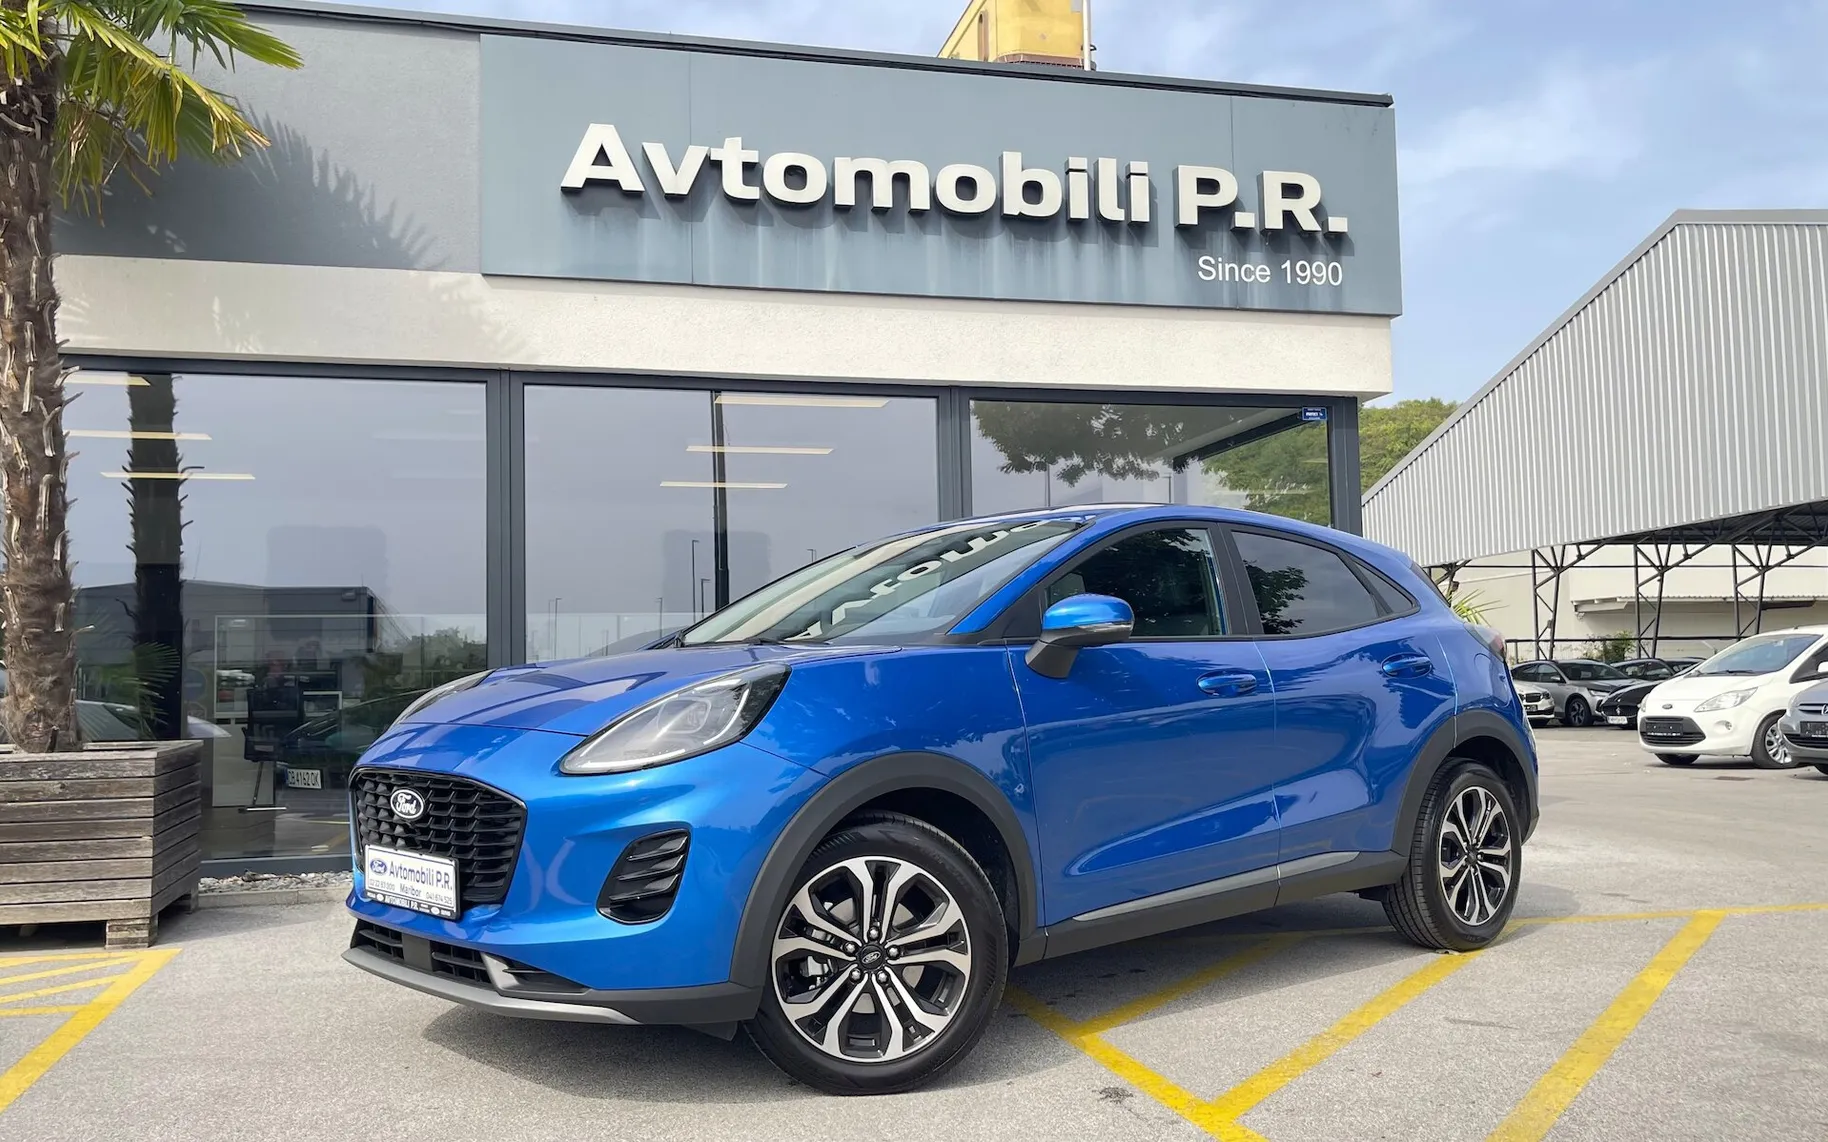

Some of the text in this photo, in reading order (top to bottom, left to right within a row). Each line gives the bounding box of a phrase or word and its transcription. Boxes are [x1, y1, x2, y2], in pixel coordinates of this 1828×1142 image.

[561, 123, 1349, 235] Avtomobili P.R.
[1198, 255, 1344, 287] Since 1990
[395, 792, 417, 815] Ford
[389, 861, 453, 890] Avtomobili P.R.
[400, 883, 422, 897] Maribor
